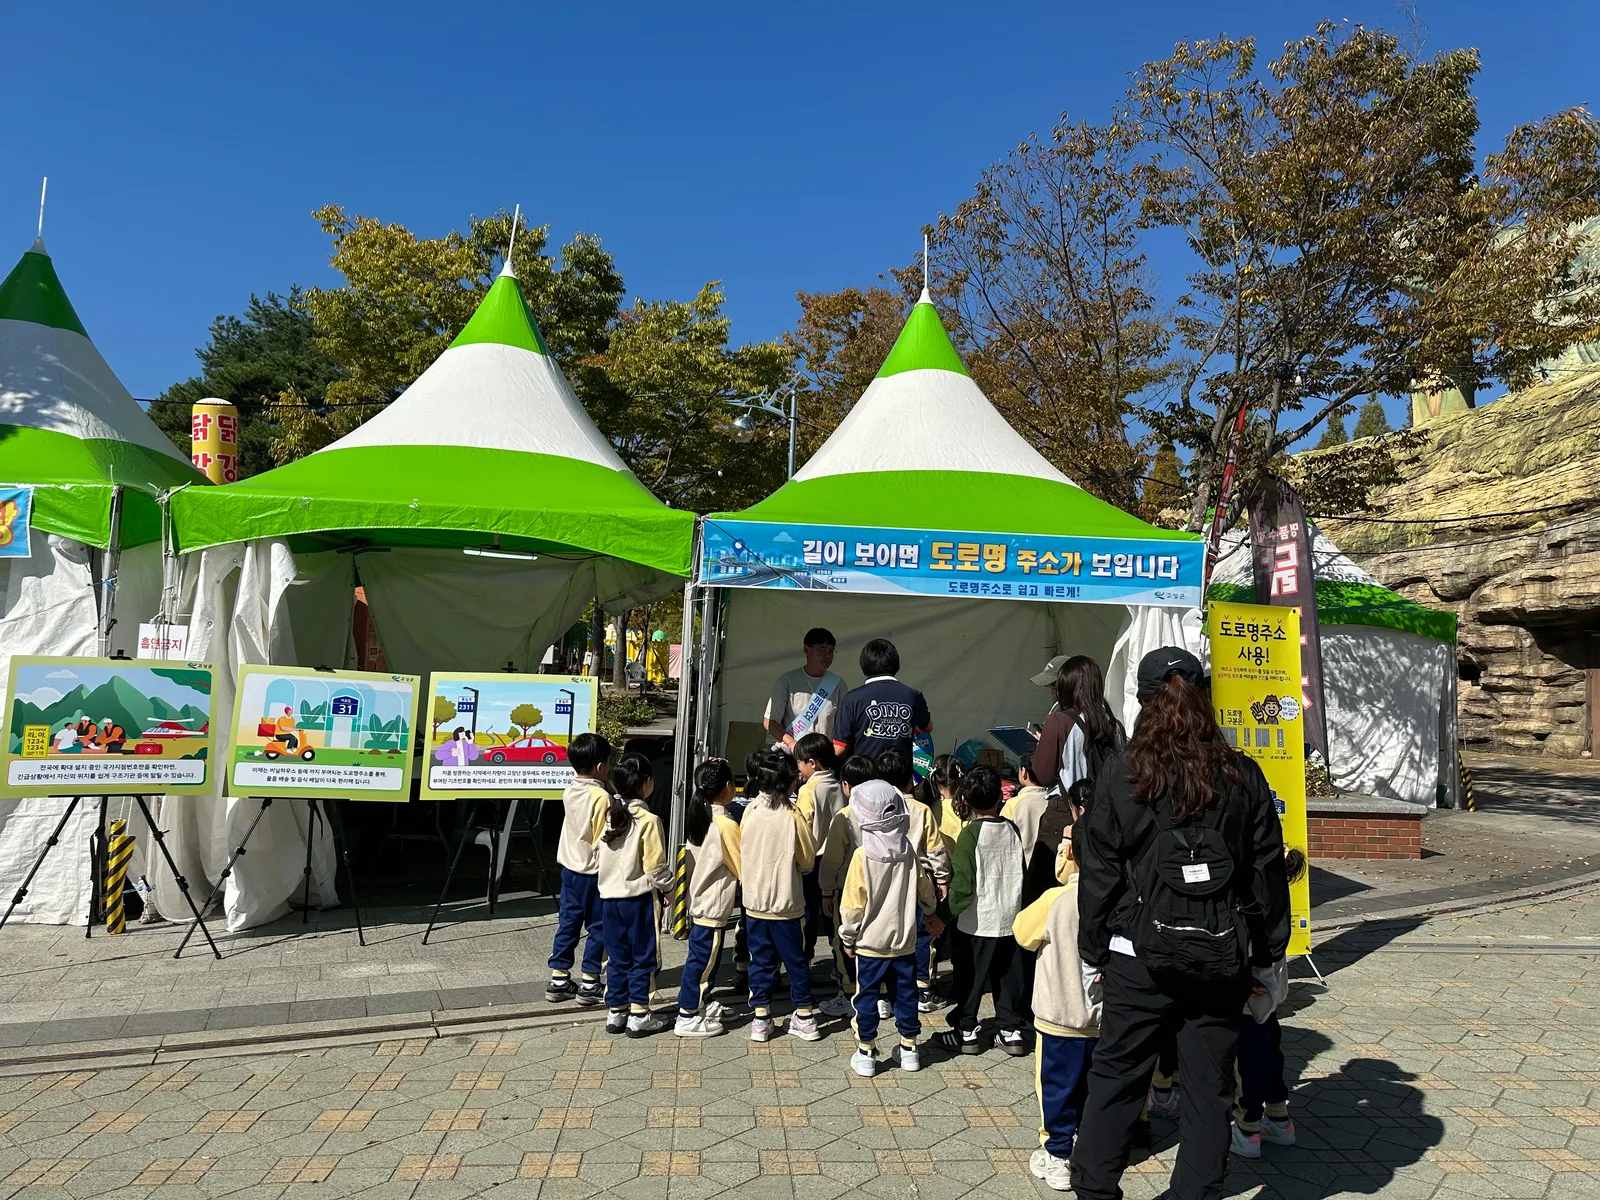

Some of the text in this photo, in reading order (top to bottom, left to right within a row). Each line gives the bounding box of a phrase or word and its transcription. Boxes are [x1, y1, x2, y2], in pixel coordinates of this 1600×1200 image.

[802, 539, 1180, 581] 길이 보이면 도로명 주소가 보입니다
[948, 581, 1080, 599] 도로명주소로 쉽고 빠르게!
[1219, 621, 1287, 643] 도로명주소
[140, 636, 183, 652] 흡연금지
[1237, 646, 1270, 666] 사용!
[338, 704, 352, 715] 31
[803, 688, 829, 722] 함께해요
[867, 704, 911, 720] DINO
[1226, 709, 1243, 718] 도로명
[1219, 708, 1224, 725] 1
[871, 721, 911, 738] EXPO
[17, 773, 56, 781] 긴급상황에서
[252, 766, 268, 774] 이제는
